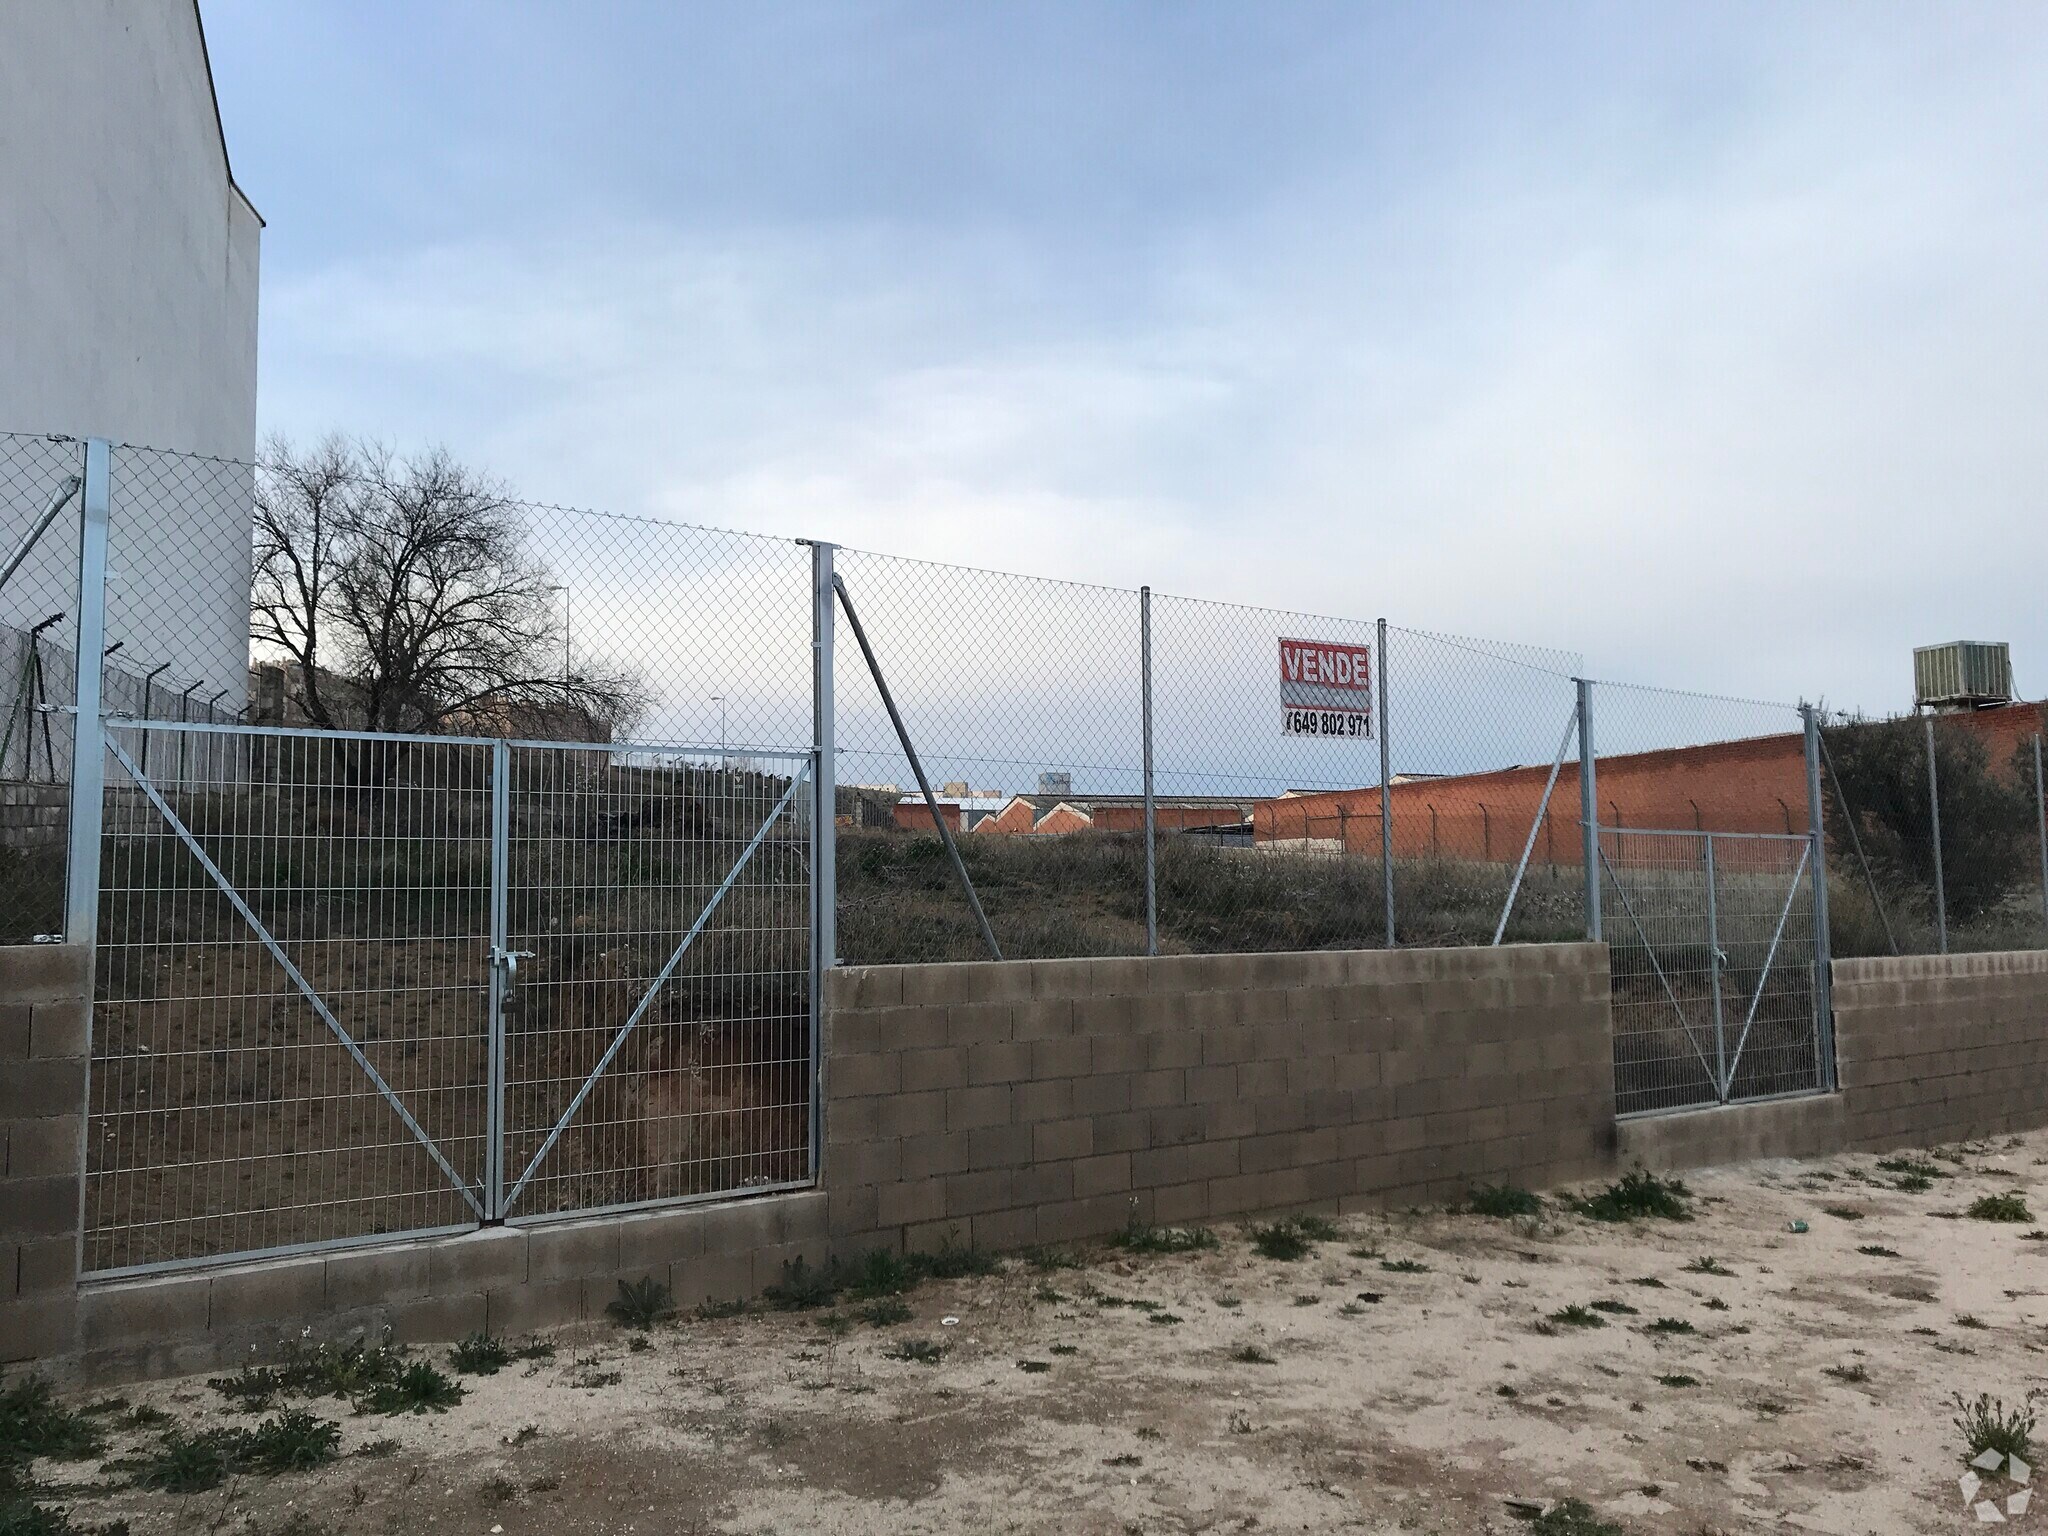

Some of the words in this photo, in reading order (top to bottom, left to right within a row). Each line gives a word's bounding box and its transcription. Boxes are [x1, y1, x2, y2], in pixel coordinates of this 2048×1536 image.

[1283, 647, 1368, 686] VENDE
[1294, 711, 1318, 734] 649
[1321, 712, 1345, 735] 802
[1348, 714, 1370, 737] 971
